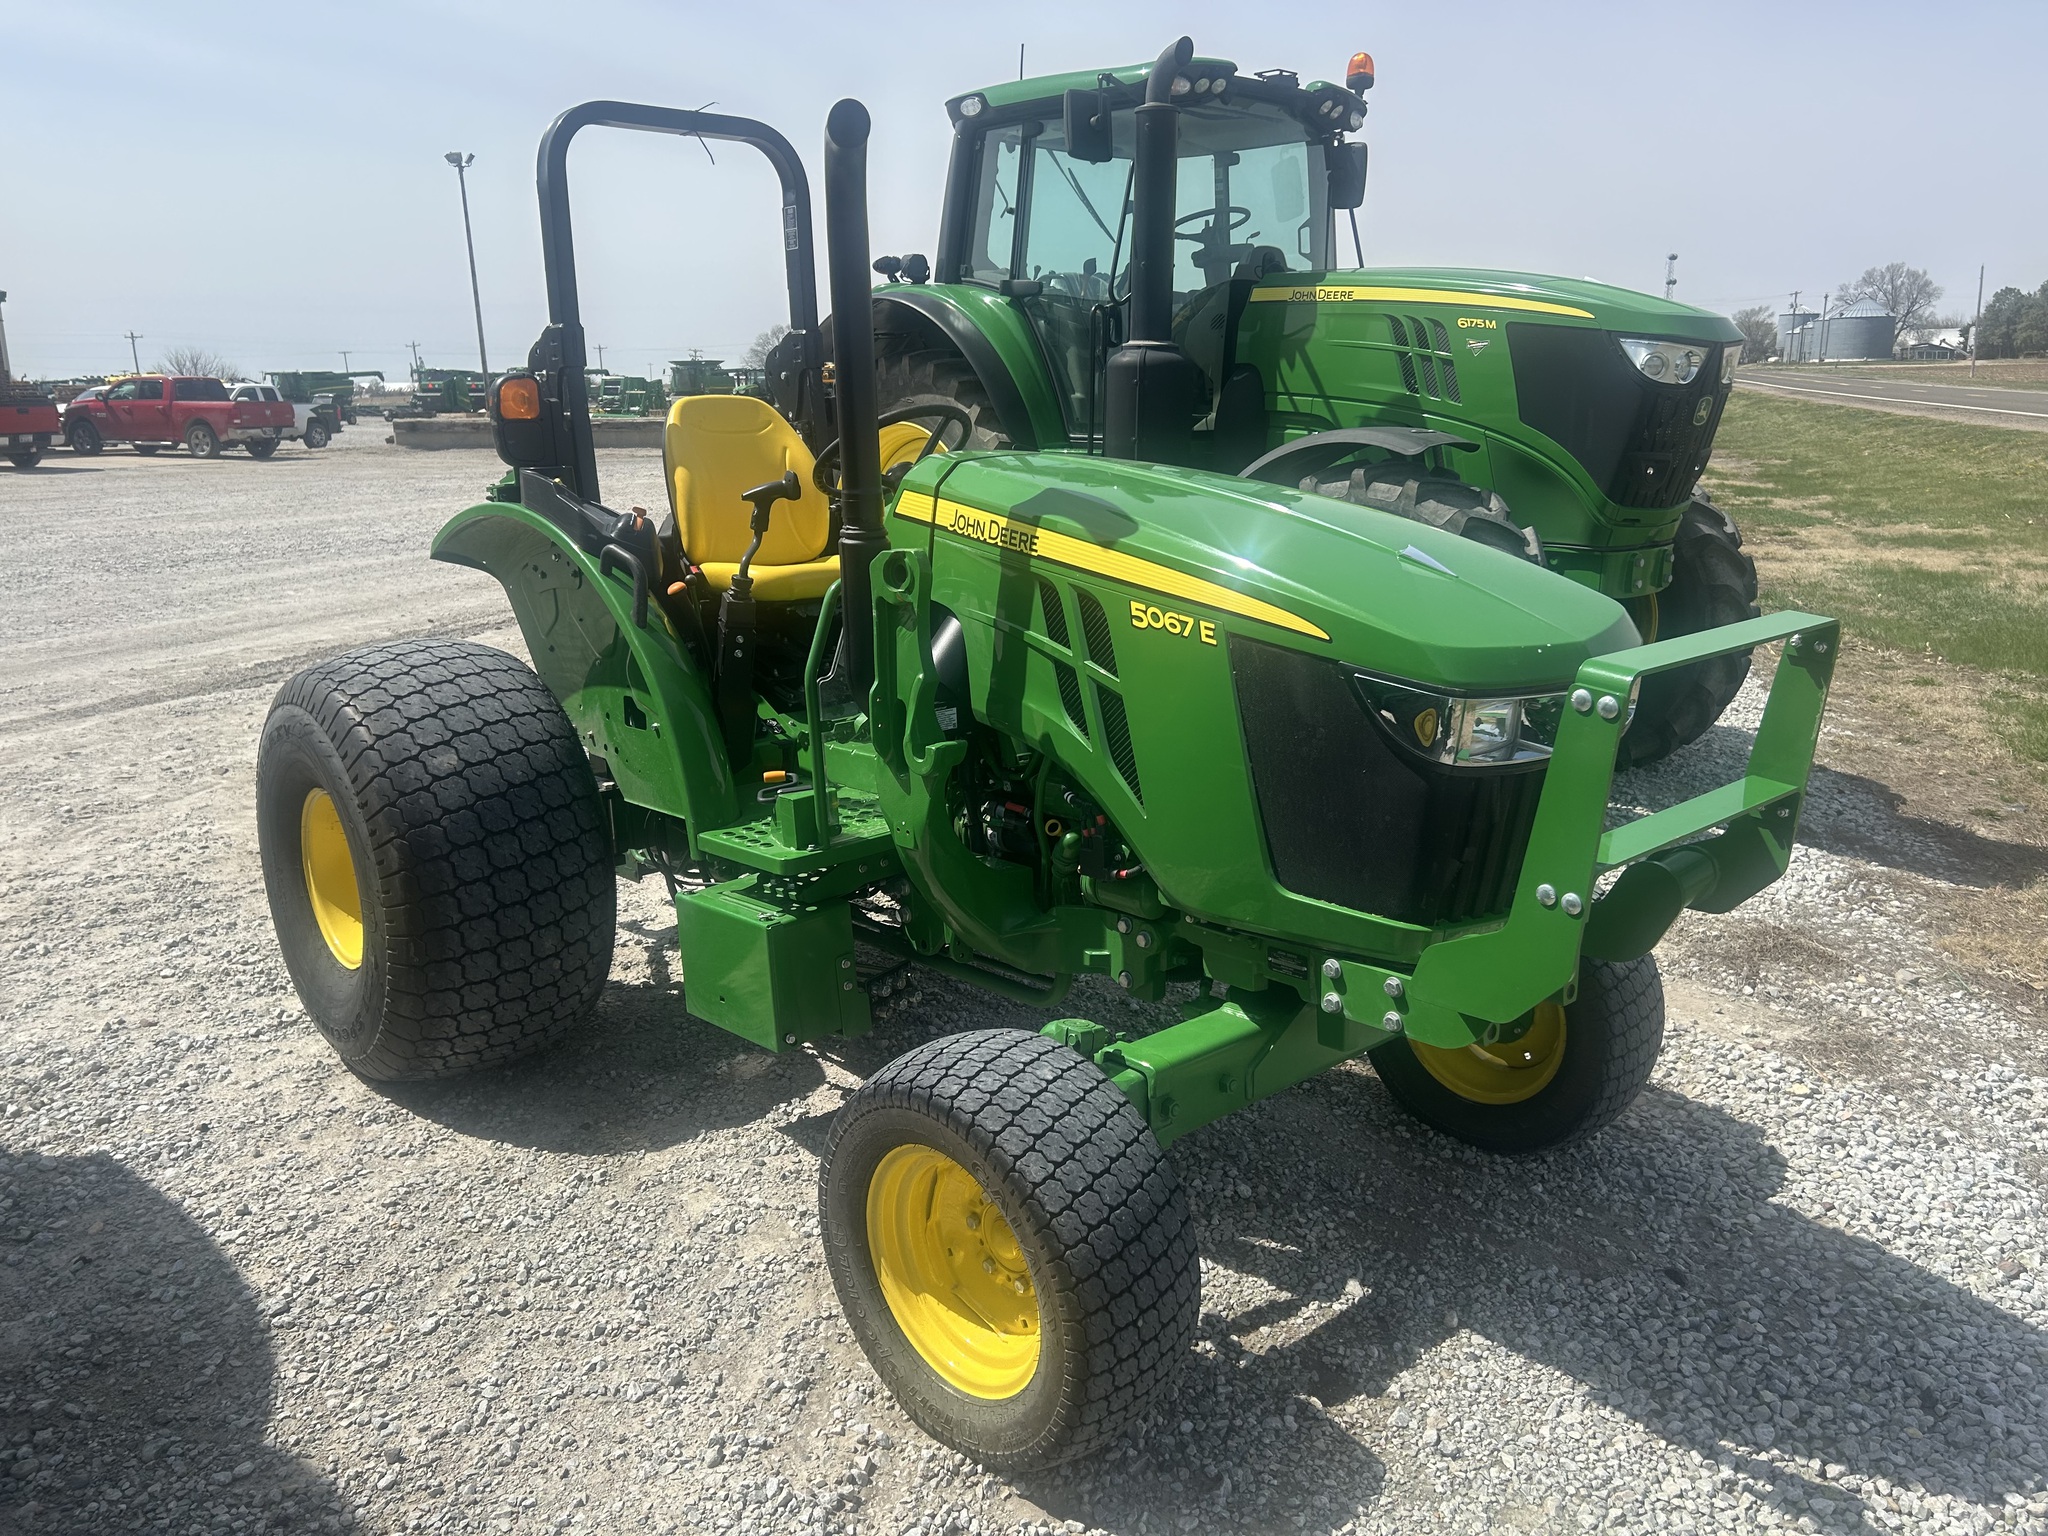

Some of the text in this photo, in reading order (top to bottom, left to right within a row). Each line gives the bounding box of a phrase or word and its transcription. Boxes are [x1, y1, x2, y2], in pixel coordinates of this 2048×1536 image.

[1289, 289, 1354, 300] JOHN DEERE
[949, 509, 1040, 553] JOHN DEERE
[1130, 600, 1218, 646] 5067 E
